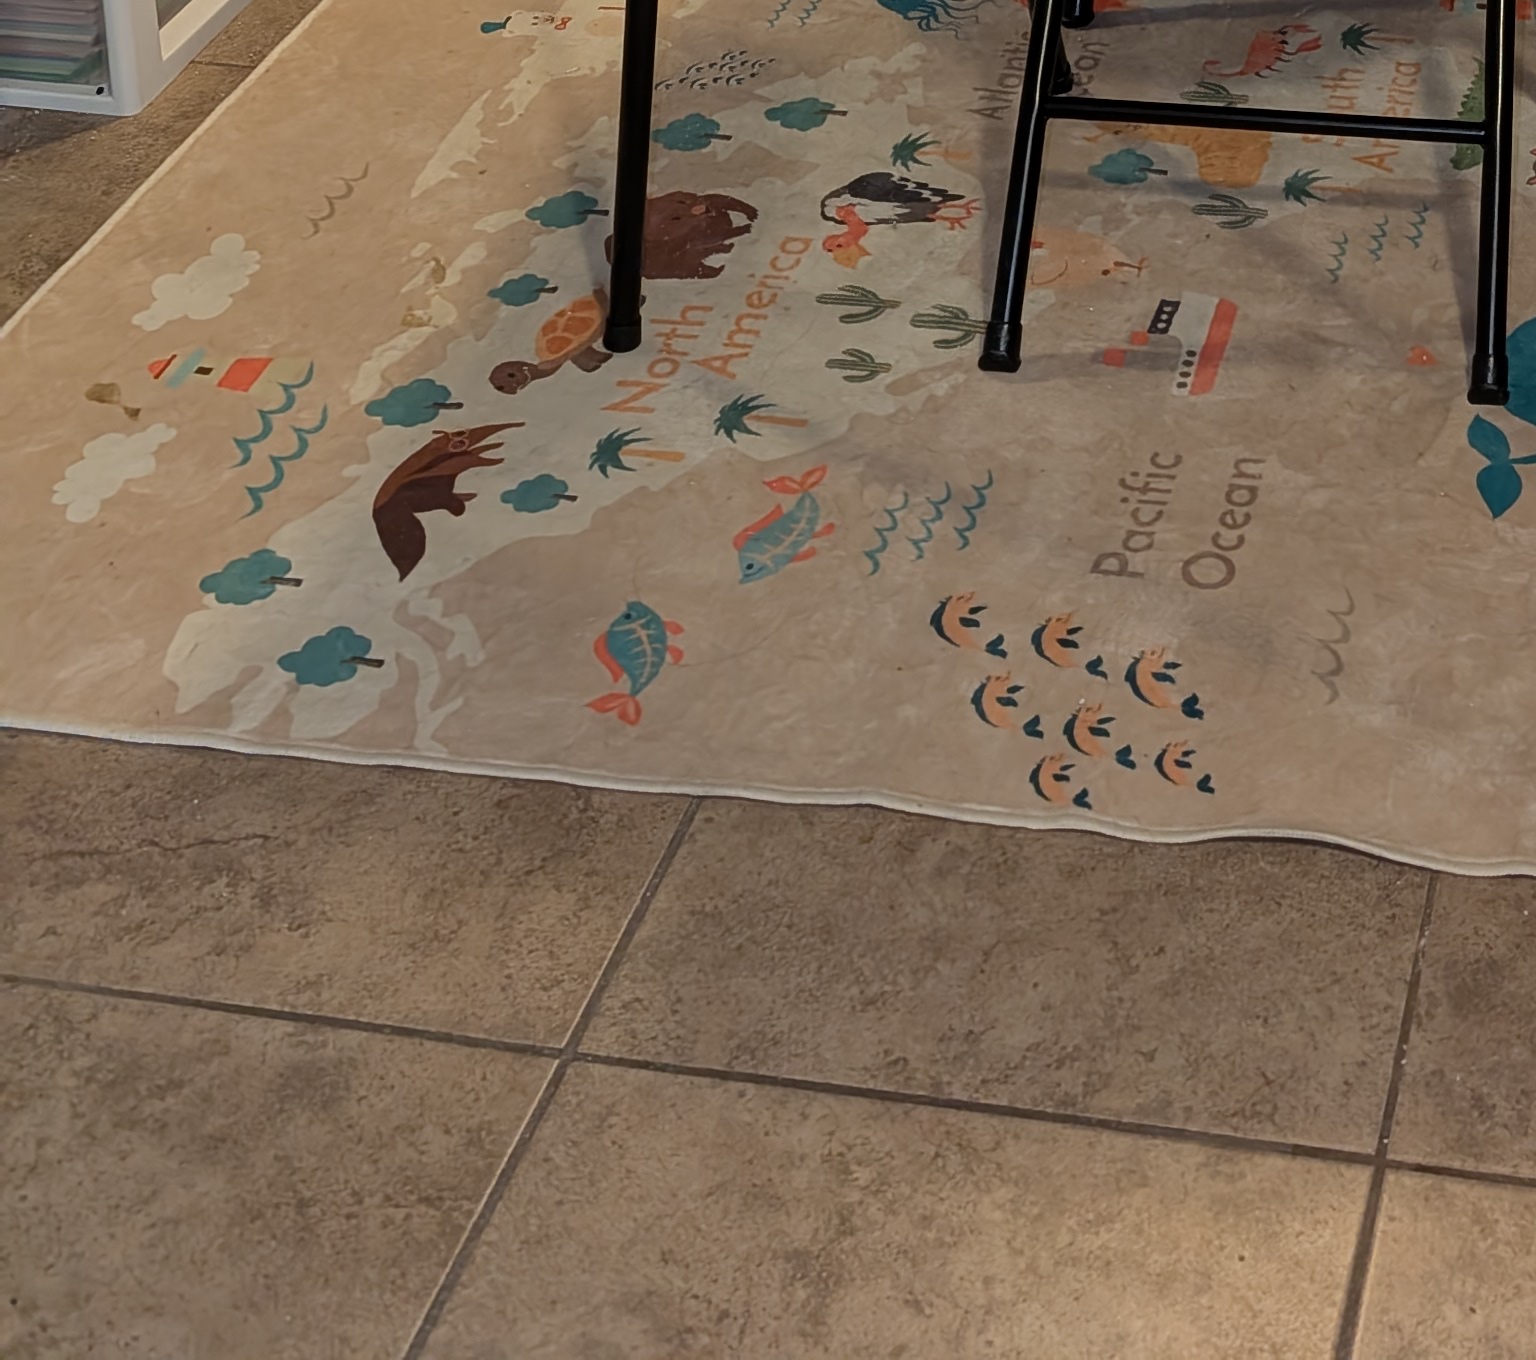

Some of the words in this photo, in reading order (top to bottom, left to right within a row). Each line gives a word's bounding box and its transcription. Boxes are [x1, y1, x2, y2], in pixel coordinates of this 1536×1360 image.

[602, 301, 712, 416] North
[697, 234, 813, 382] America
[1089, 450, 1184, 579] Pacific
[1180, 454, 1268, 592] Ocean
